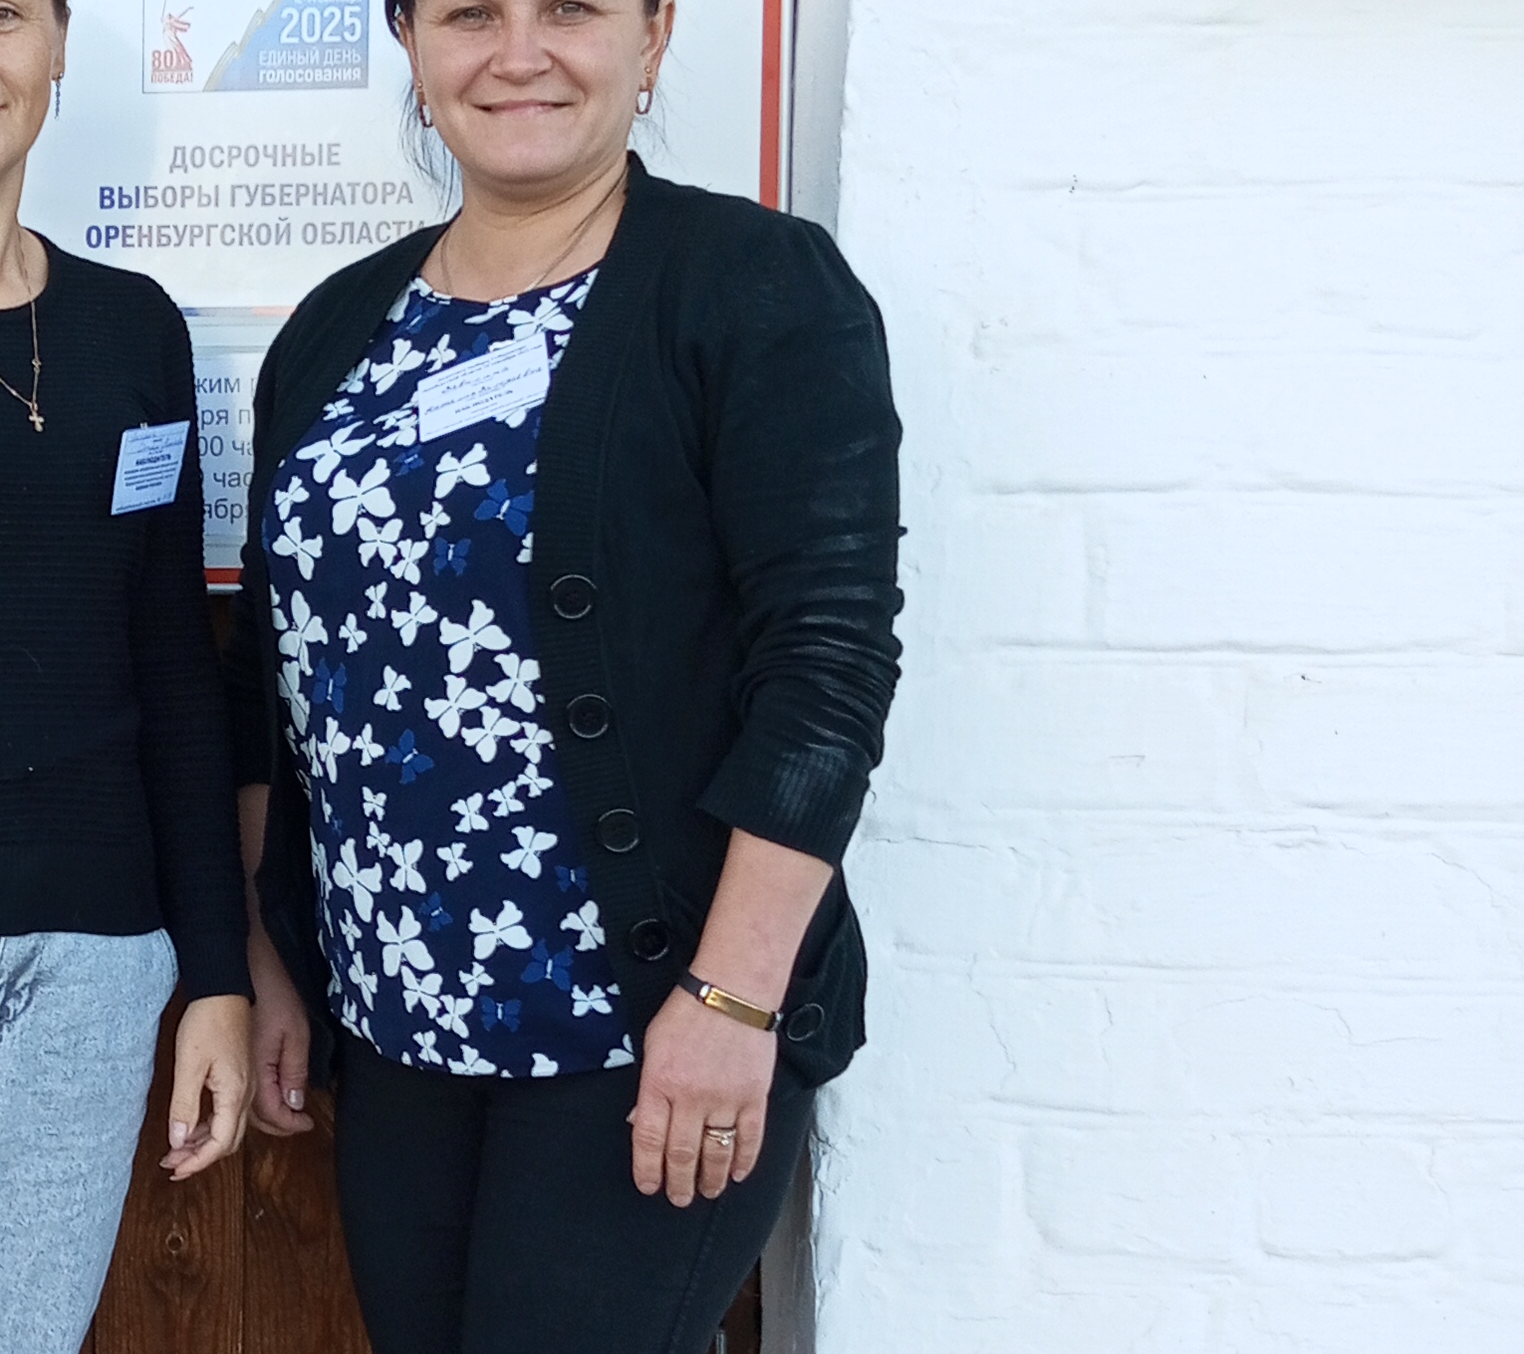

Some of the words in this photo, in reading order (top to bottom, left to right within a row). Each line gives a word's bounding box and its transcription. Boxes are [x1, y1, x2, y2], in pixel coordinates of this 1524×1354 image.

[280, 5, 362, 44] 2025
[152, 49, 174, 69] 80
[259, 46, 320, 66] ЕДИНЫЙ
[323, 47, 362, 67] ДЕНЬ
[258, 66, 362, 84] голосования
[169, 143, 341, 174] ДОСРОЧНЫЕ
[99, 184, 220, 210] ВЫБОРЫ
[231, 181, 414, 208] ГУБЕРНАТОРА
[85, 217, 291, 249] ОРЕНБУРГСКОЙ
